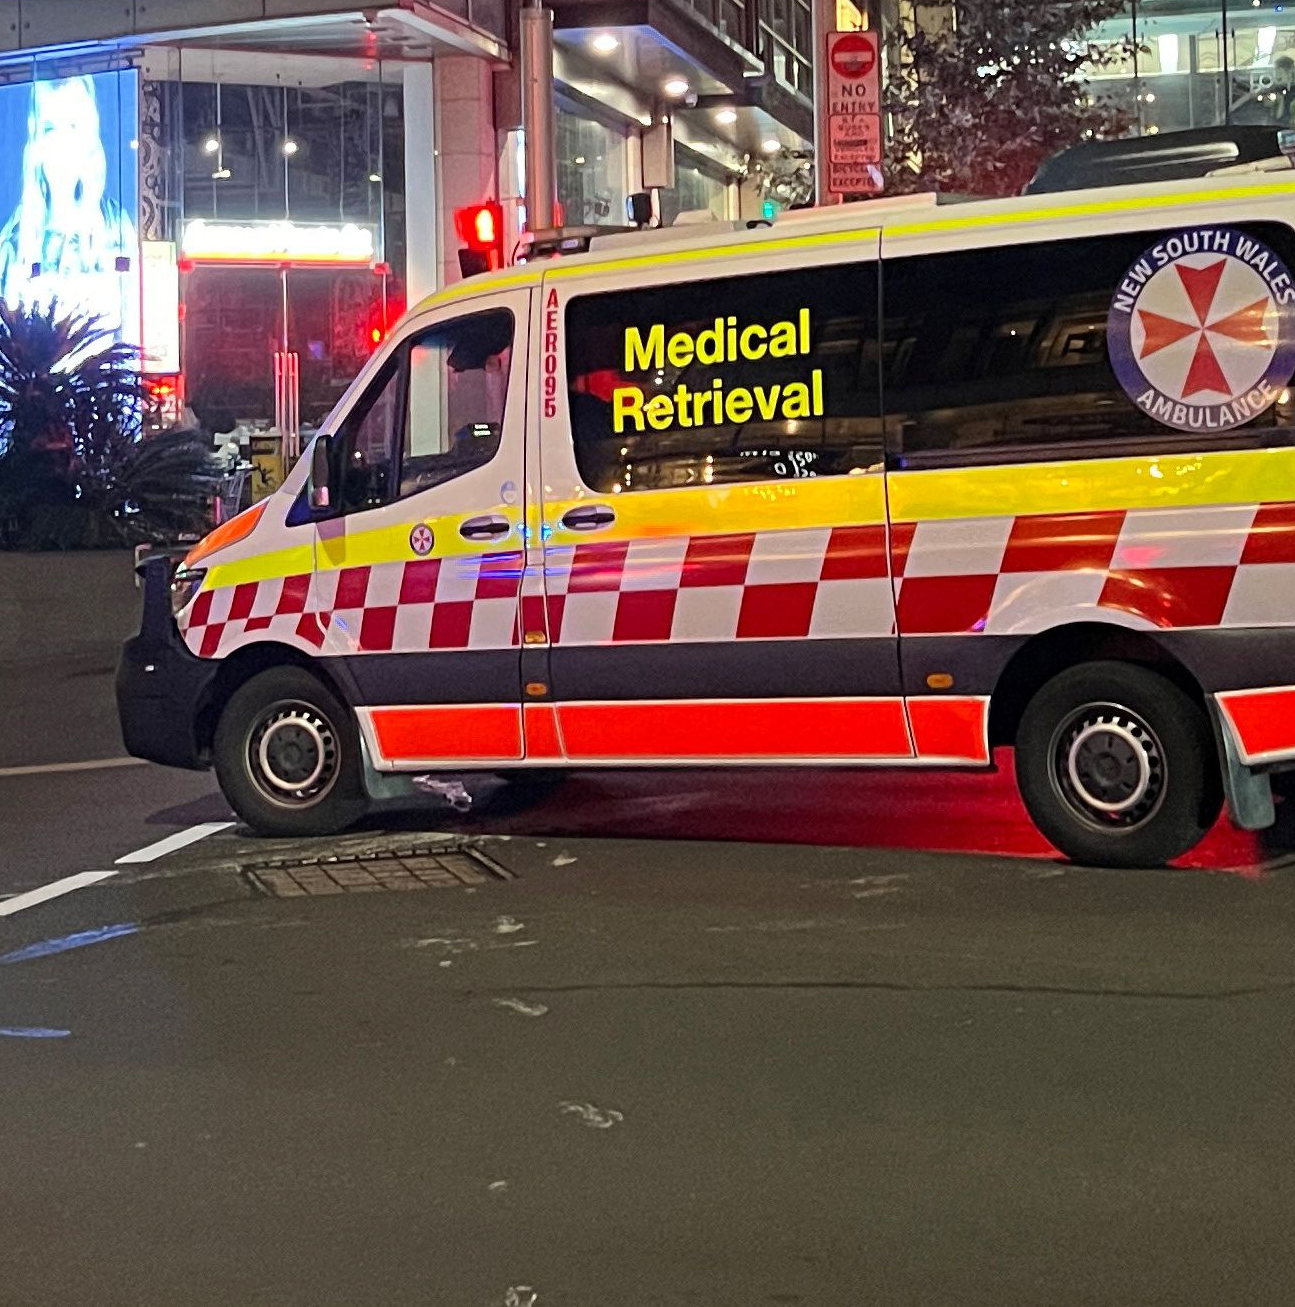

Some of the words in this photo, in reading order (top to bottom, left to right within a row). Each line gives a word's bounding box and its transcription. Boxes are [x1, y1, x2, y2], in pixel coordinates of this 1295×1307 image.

[832, 101, 876, 114] ENTRY
[841, 83, 867, 98] NO
[1113, 258, 1153, 313] NEW
[1152, 230, 1231, 266] SOUTH
[1235, 236, 1295, 305] WALES
[624, 307, 811, 372] Medical
[612, 369, 824, 434] Retrieval
[1137, 378, 1278, 429] AMBULANCE
